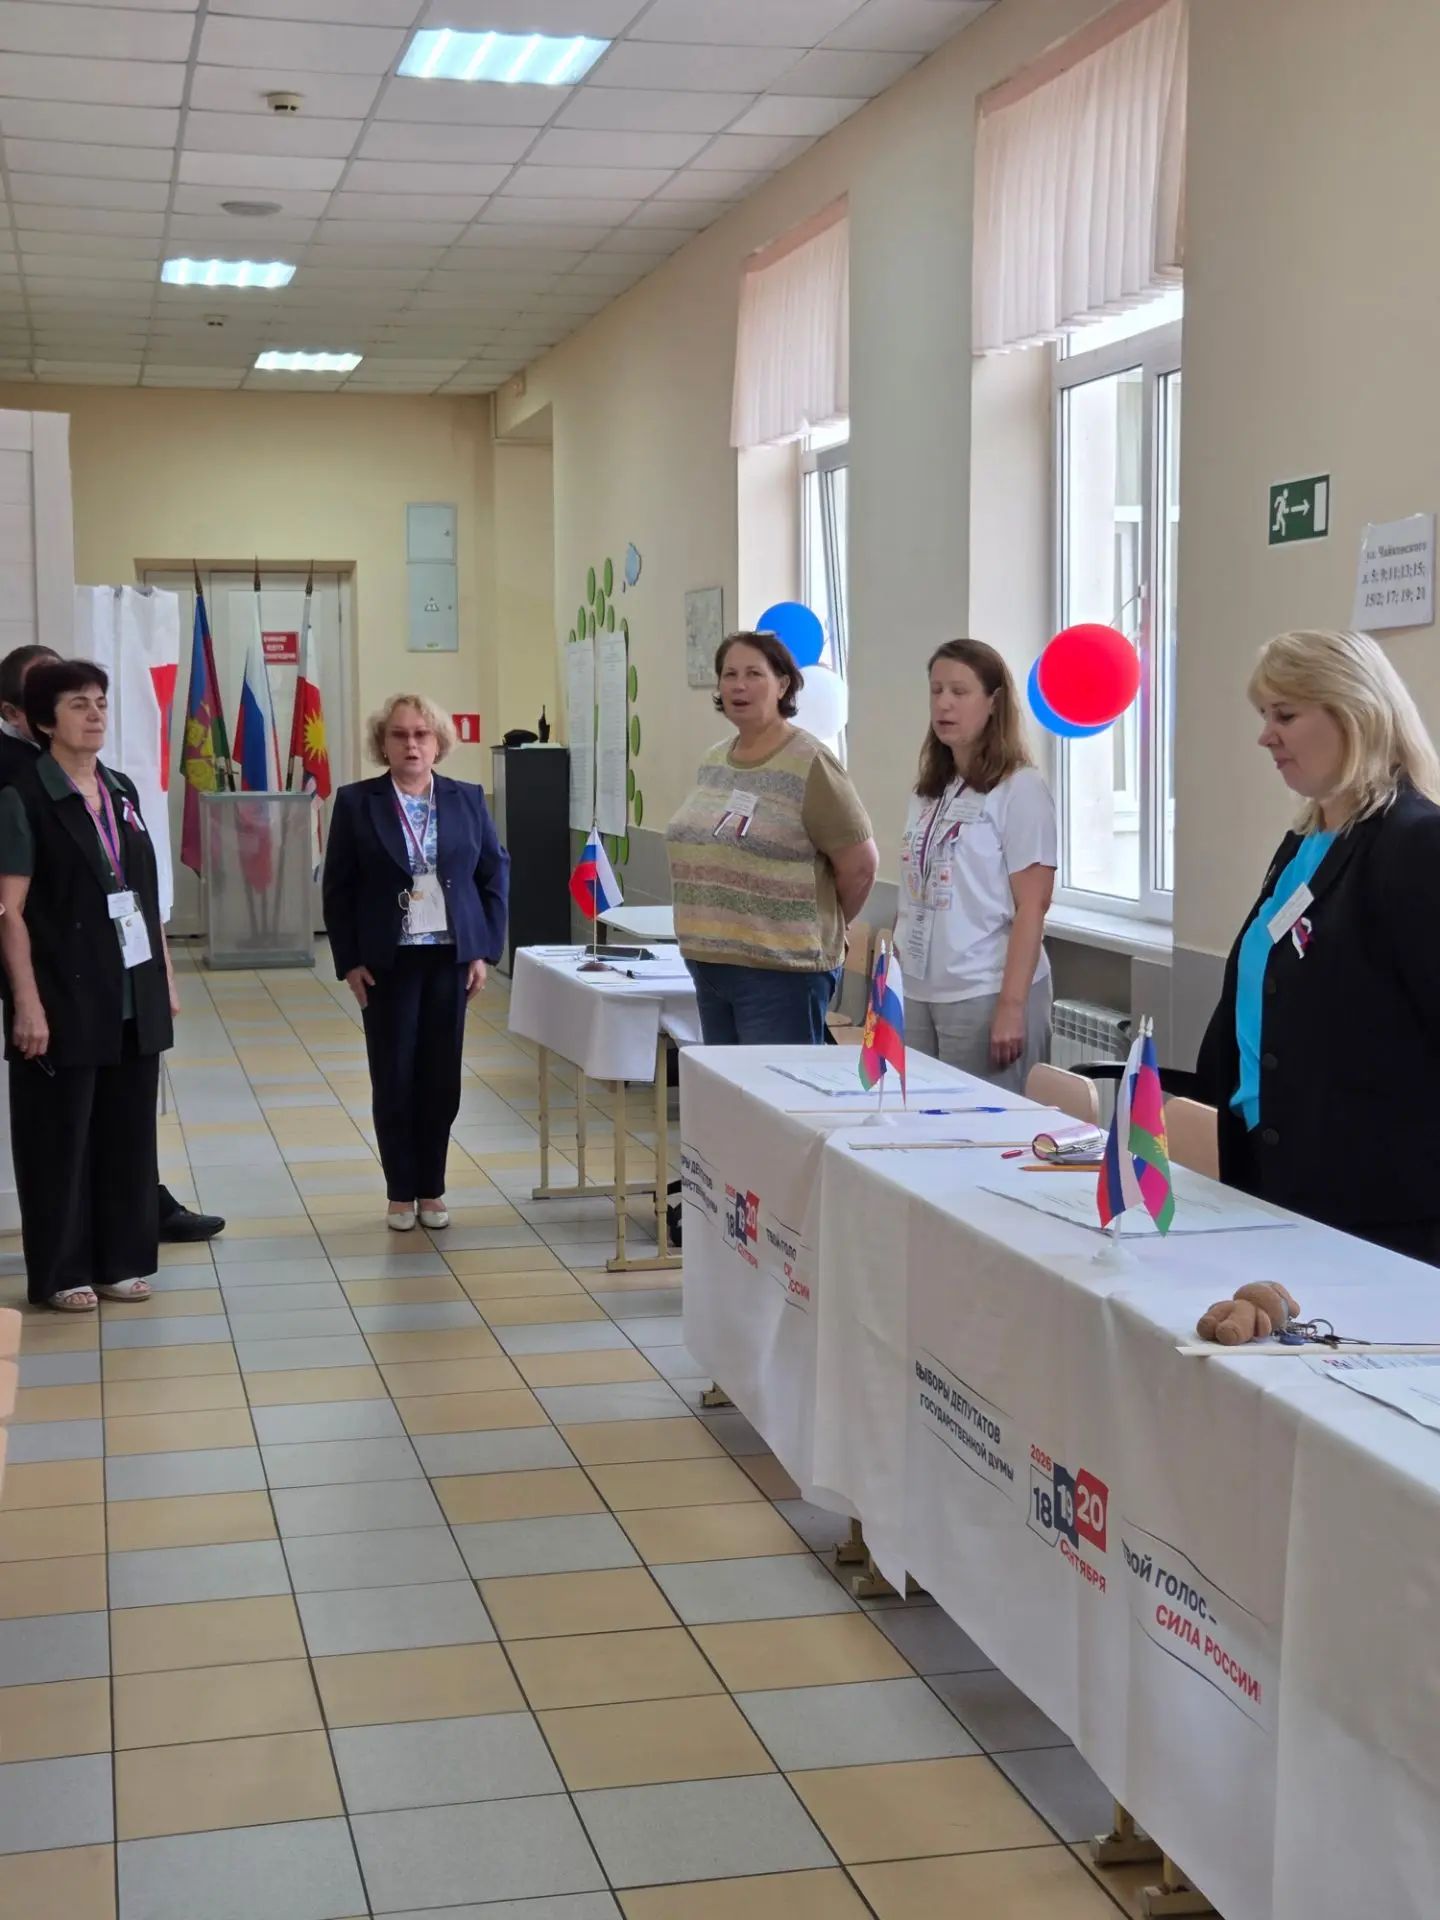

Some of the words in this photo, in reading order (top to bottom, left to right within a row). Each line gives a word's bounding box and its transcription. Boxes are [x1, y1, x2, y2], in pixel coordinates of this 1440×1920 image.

[916, 1360, 950, 1401] ВЫБОРЫ
[950, 1389, 1001, 1444] ДЕПУТАТОВ
[919, 1392, 987, 1460] ГОСУДАРСТВЕННОЙ
[987, 1452, 1014, 1481] ДУМЫ
[1030, 1444, 1052, 1472] 2026
[1033, 1487, 1053, 1528] 18
[1058, 1484, 1074, 1527] 19
[1076, 1484, 1104, 1532] 20
[1155, 1567, 1206, 1619] ГОЛОС
[1156, 1604, 1200, 1651] СИЛА
